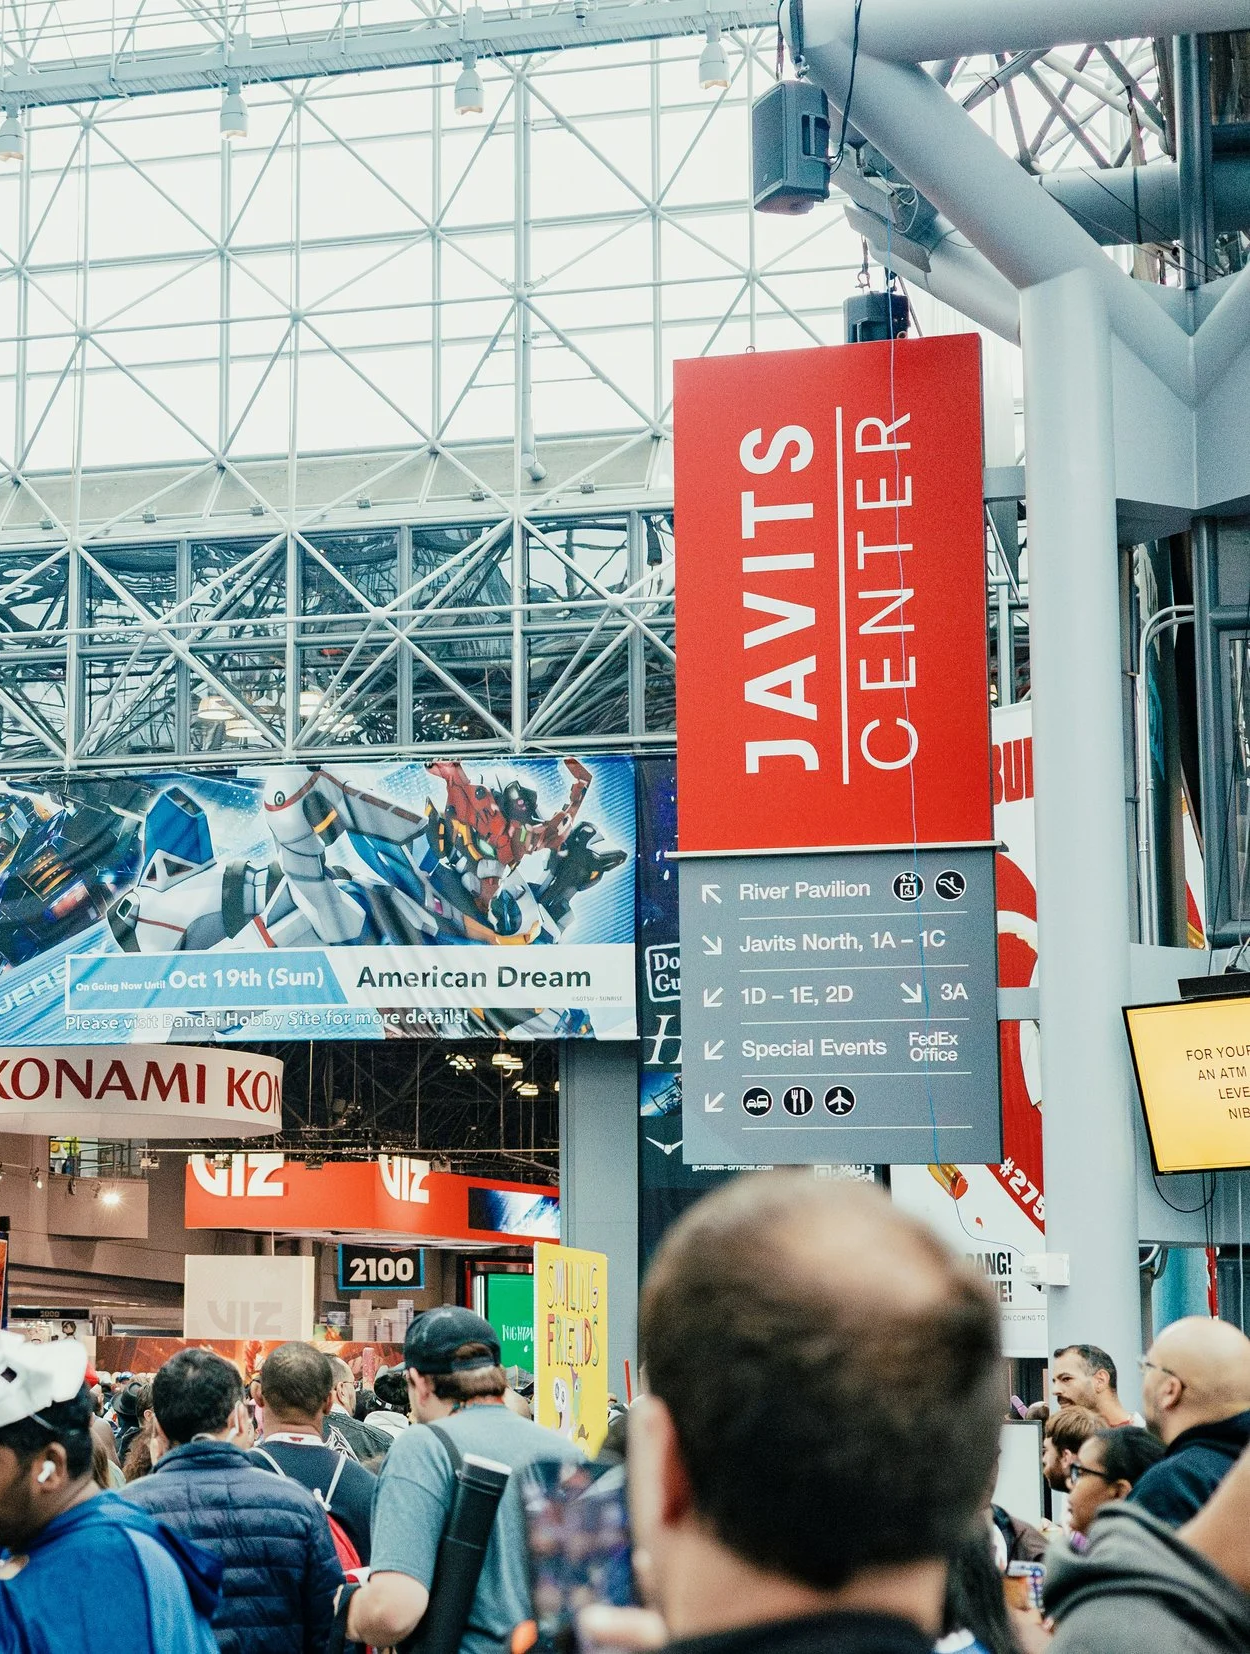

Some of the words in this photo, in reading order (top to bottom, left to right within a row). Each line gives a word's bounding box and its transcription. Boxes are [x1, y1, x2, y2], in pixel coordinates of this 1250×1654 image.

[739, 424, 820, 774] JAVITS
[854, 412, 920, 771] CENTER
[739, 883, 790, 900] River
[795, 880, 871, 899] Pavilion
[739, 934, 797, 952] Javits
[802, 932, 864, 953] North,
[871, 931, 896, 949] 1A
[920, 930, 946, 948] 1C
[75, 982, 90, 991] On
[91, 981, 119, 992] Going
[121, 981, 142, 990] Now
[143, 980, 166, 990] Until
[168, 969, 206, 989] Oct
[213, 967, 262, 988] 19th
[267, 967, 324, 990] (Sun)
[356, 966, 487, 988] American
[497, 966, 591, 988] Dream
[741, 987, 766, 1005] 1D
[790, 986, 819, 1006] 1E,
[825, 985, 853, 1003] 2D
[940, 983, 969, 1001] 3A
[65, 1015, 125, 1031] Please
[127, 1014, 159, 1030] visit
[163, 1012, 221, 1029] Bandai
[226, 1012, 284, 1030] Hobby
[288, 1011, 321, 1027] Site
[325, 1010, 350, 1025] for
[355, 1012, 401, 1025] more
[405, 1008, 469, 1025] details!
[741, 1039, 814, 1060] Special
[820, 1038, 888, 1056] Events
[909, 1032, 958, 1046] FedEx
[909, 1047, 958, 1062] Office
[1186, 1048, 1213, 1061] FOR
[1198, 1068, 1215, 1080] AN
[1220, 1066, 1247, 1079] ATM
[191, 1153, 284, 1197] VIZ
[378, 1154, 430, 1204] VIZ
[349, 1257, 414, 1282] 2100
[547, 1258, 598, 1314] SMILING
[207, 1301, 283, 1336] VIZ
[548, 1313, 599, 1367] FRIENDS
